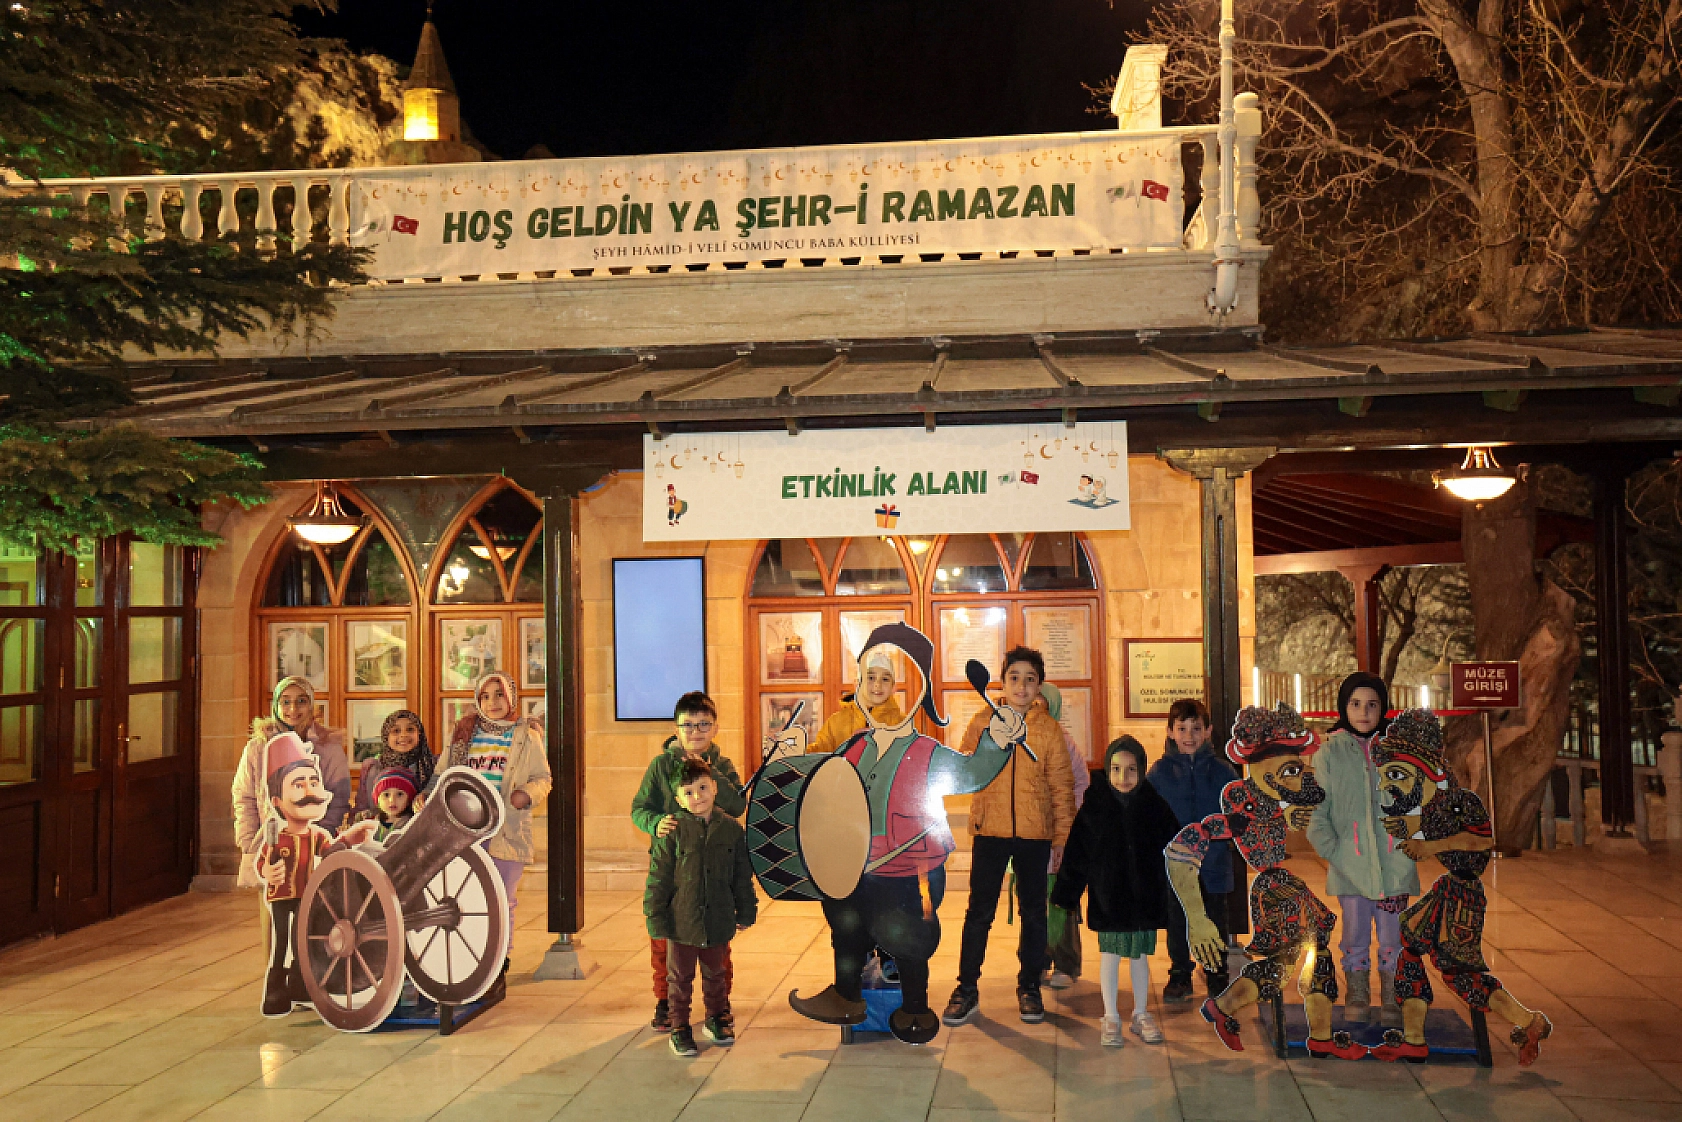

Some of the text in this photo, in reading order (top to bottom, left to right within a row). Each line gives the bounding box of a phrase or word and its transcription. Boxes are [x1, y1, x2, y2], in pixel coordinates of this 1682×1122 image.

[443, 182, 1076, 249] HOŞ GELDİN YA ŞEHR-İ RAMAZAN
[593, 245, 627, 260] ŞEYH
[731, 237, 805, 251] SOMUNCU
[810, 237, 845, 249] BABA
[850, 232, 920, 247] KÜLLİYESİ
[782, 466, 987, 499] ETKİNLİK ALANI
[1464, 667, 1506, 679] MÜZE
[1464, 679, 1508, 692] GİRİŞİ
